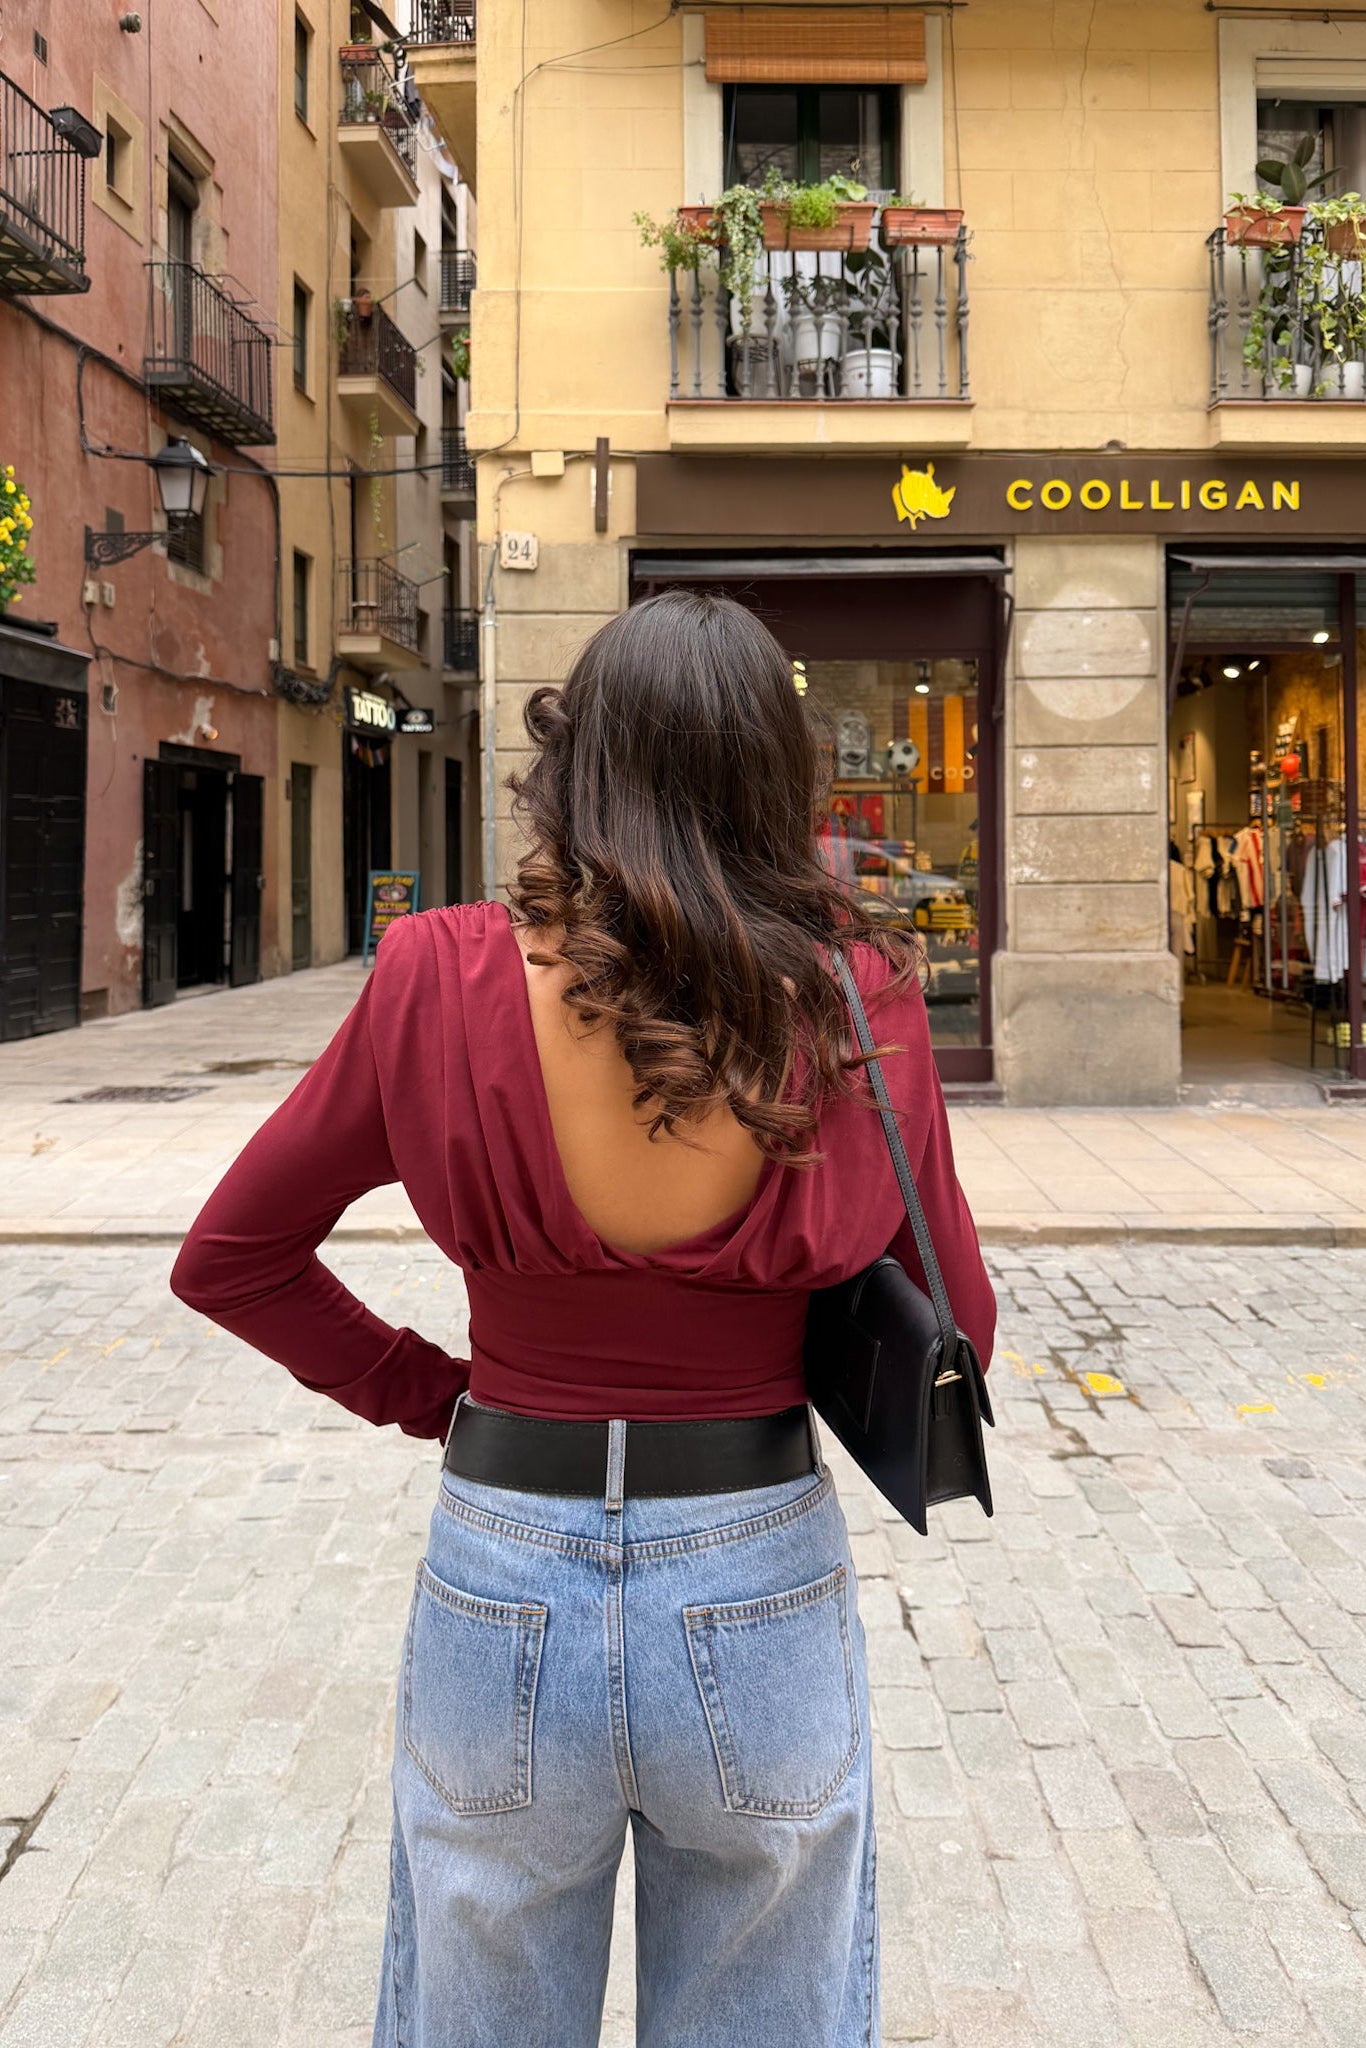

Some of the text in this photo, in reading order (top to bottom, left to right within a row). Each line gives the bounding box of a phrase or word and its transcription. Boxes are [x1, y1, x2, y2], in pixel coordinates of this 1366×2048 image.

[1006, 479, 1300, 510] COOLLIGAN
[508, 539, 531, 560] 24
[352, 694, 396, 730] TATTOO
